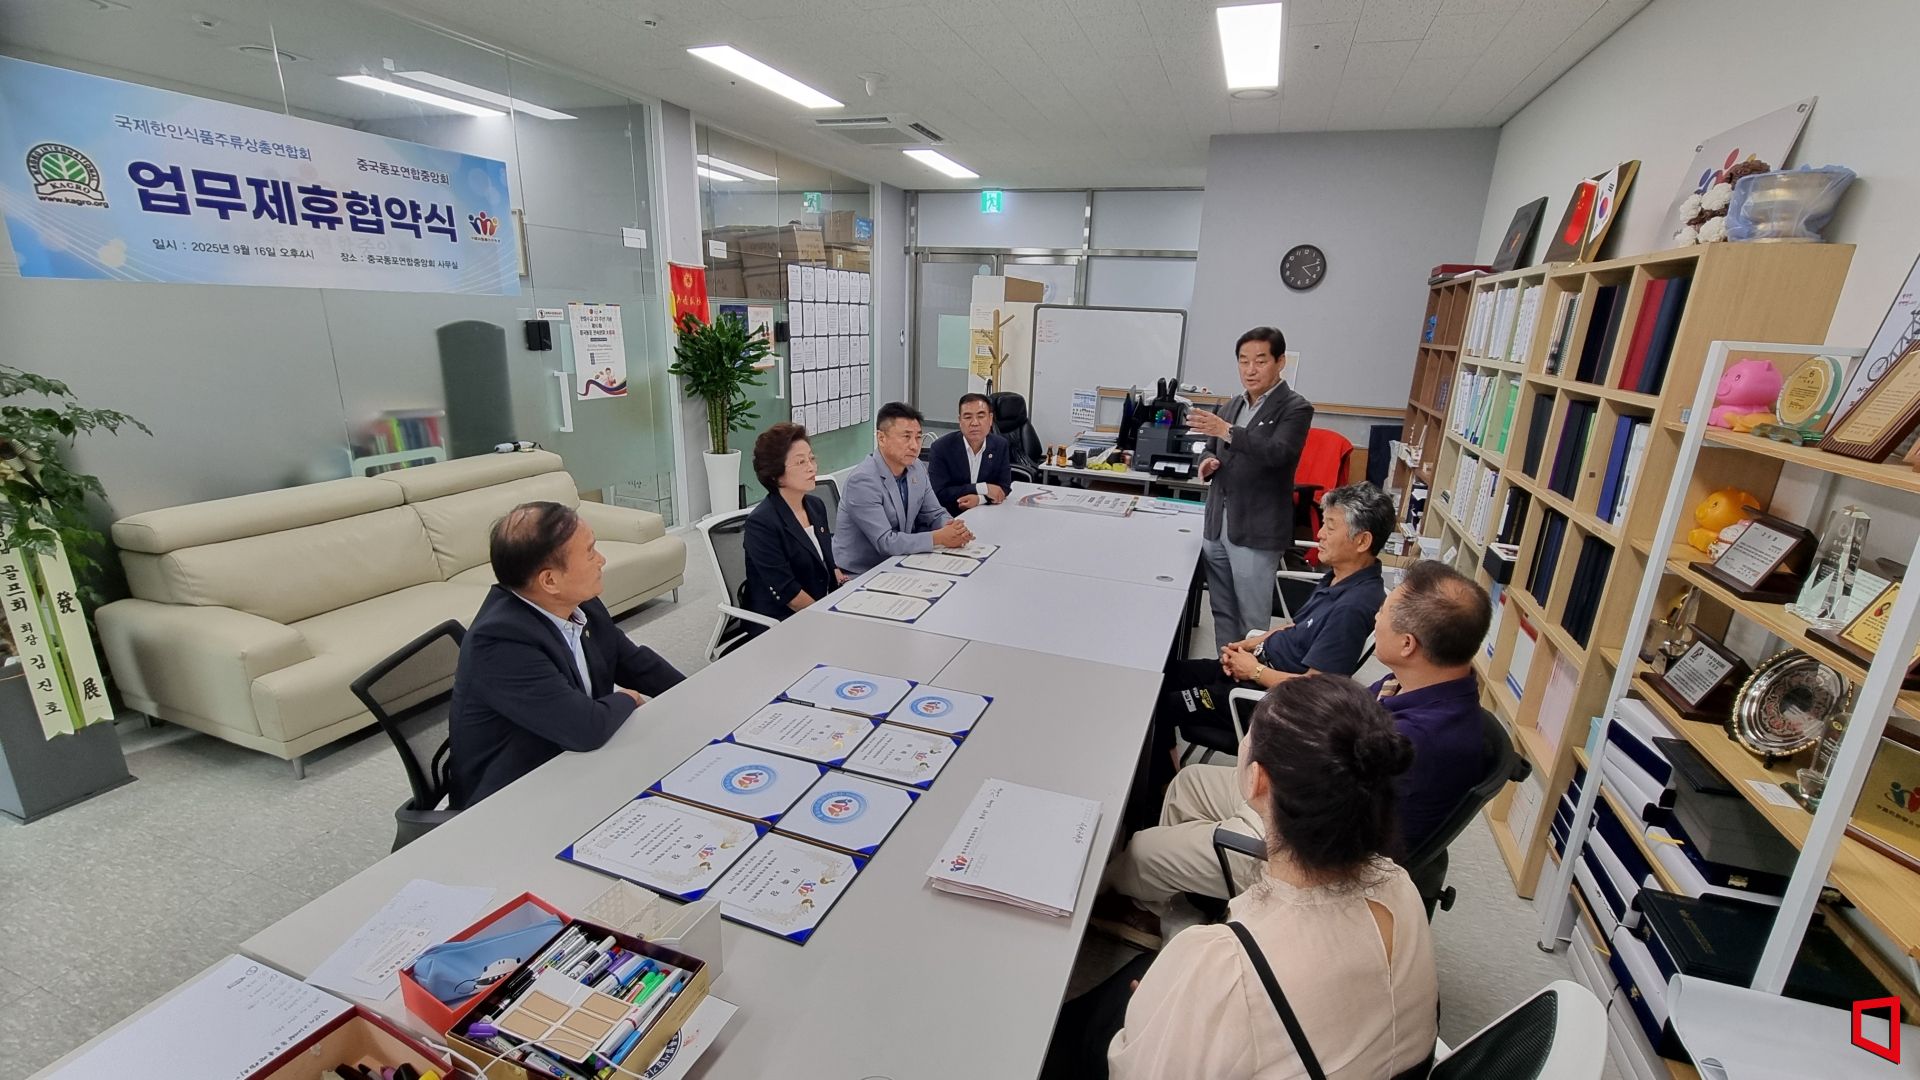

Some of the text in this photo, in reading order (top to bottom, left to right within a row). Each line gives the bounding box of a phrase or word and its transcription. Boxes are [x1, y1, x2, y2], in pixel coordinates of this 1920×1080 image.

[114, 114, 312, 162] 국제한인식품주류상총연합회
[356, 157, 450, 186] 중국동포연합중앙회
[49, 182, 91, 194] KAGRO
[37, 195, 109, 209] www.kagro.org
[127, 160, 458, 243] 업무제휴협약식
[152, 238, 178, 251] 일시
[191, 241, 230, 255] 2025년
[232, 244, 251, 256] 9월
[254, 246, 276, 258] 16일
[279, 247, 315, 260] 오후4시
[340, 252, 358, 263] 장소
[367, 254, 436, 268] 중국동포연합중앙회
[438, 260, 459, 270] 사무실
[0, 565, 28, 612] 골프회
[20, 622, 38, 646] 회장
